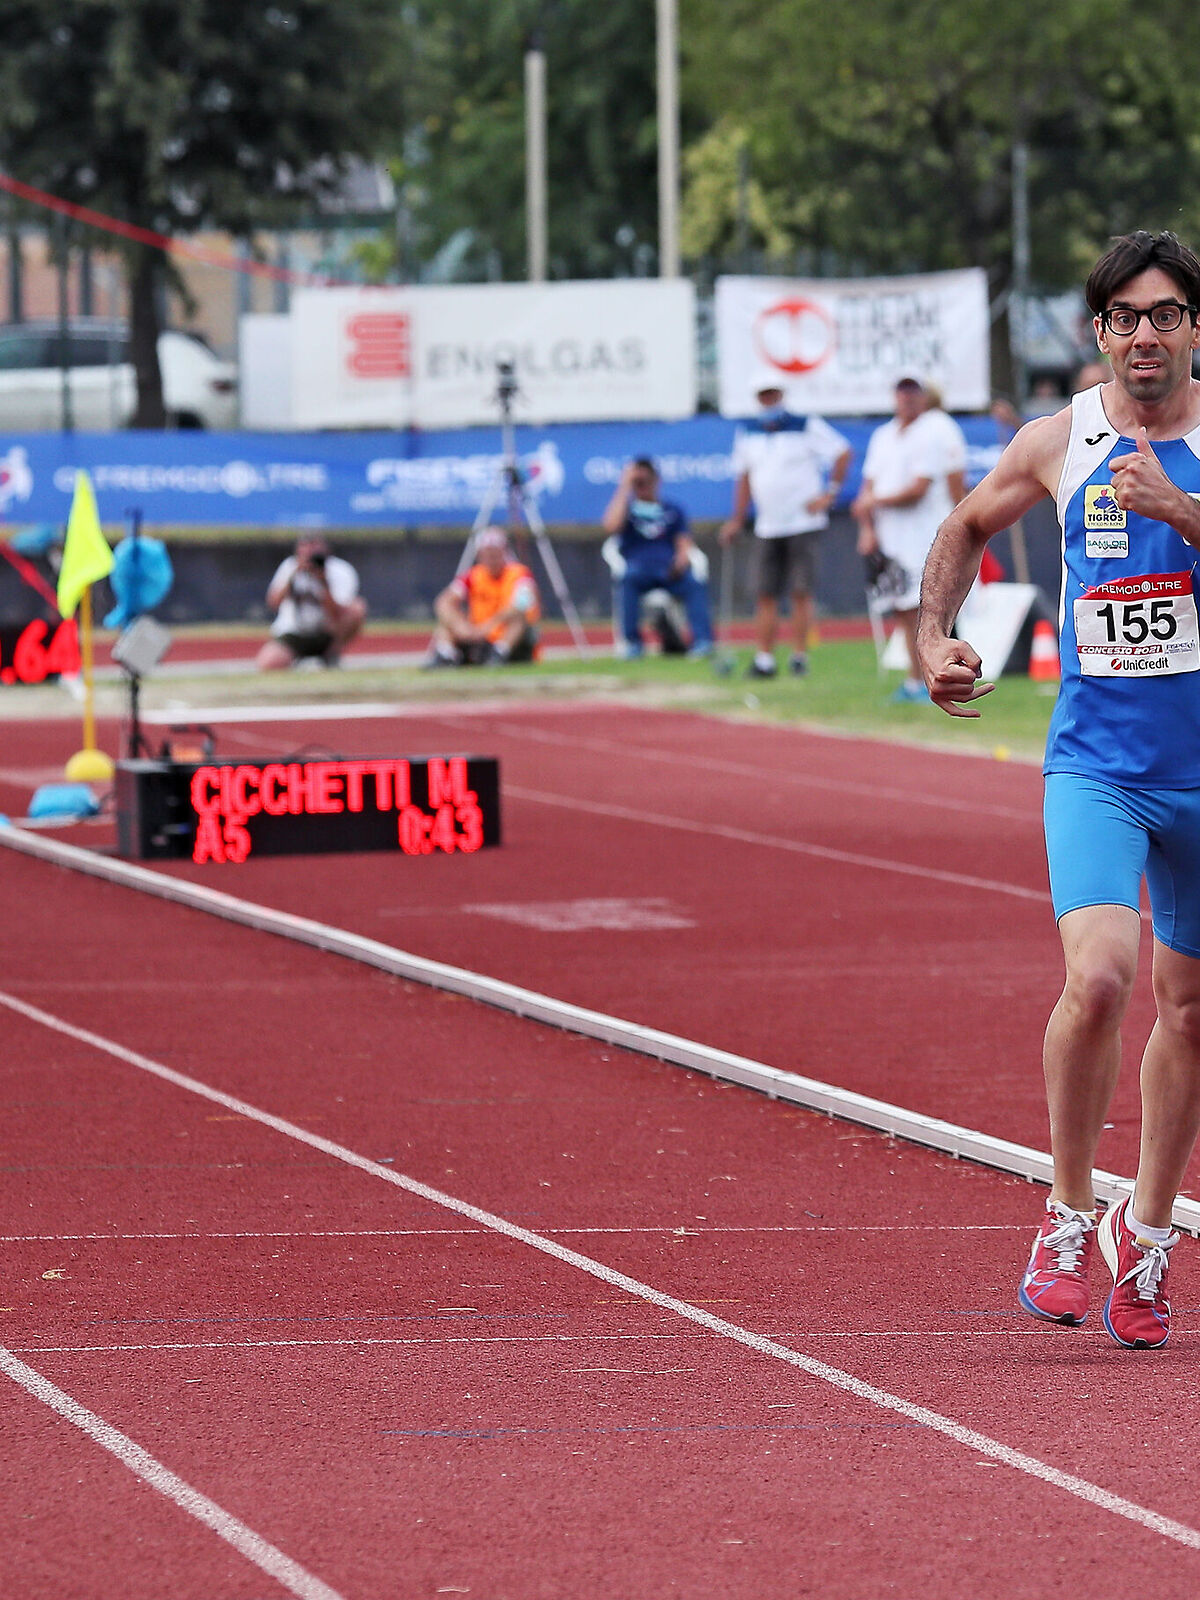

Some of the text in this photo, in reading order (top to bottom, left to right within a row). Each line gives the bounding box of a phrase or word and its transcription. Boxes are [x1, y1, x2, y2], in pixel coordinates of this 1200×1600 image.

[425, 336, 648, 380] ENOLGAS
[1087, 514, 1124, 522] TIGROS
[1096, 600, 1177, 644] 155
[0, 617, 83, 685] .64
[1081, 646, 1133, 655] CONCESIO
[1123, 657, 1170, 671] UniCredit
[190, 759, 411, 816] CICCHETTI
[193, 804, 484, 864] A5 0:43
